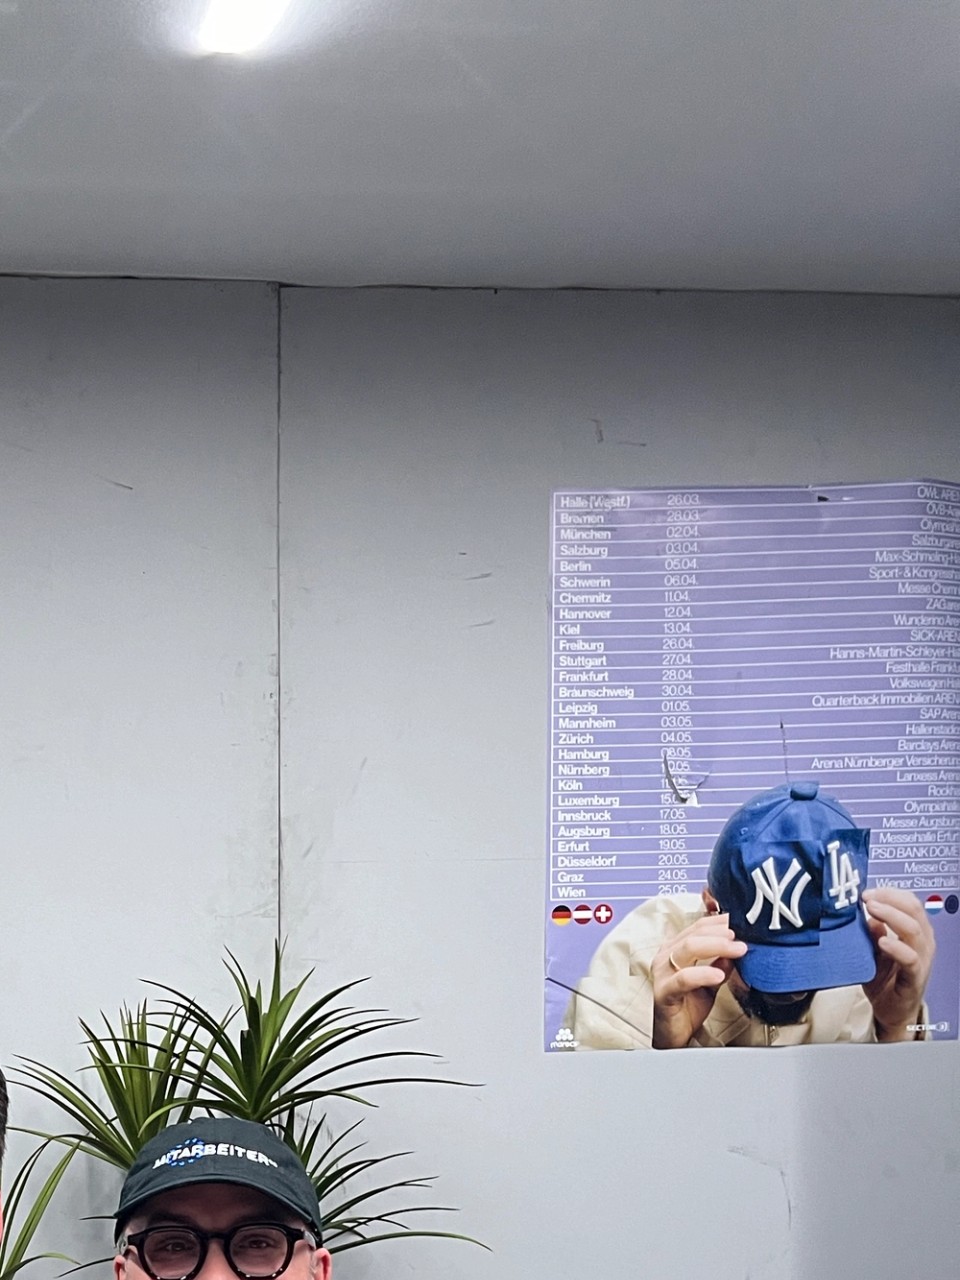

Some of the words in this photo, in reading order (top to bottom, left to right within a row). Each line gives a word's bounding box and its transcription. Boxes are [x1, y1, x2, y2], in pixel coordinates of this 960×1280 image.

[560, 512, 604, 524] Bremen
[560, 528, 611, 540] München
[560, 544, 608, 558] Salzburg
[559, 561, 591, 572] Berlin
[559, 576, 611, 588] Schwerin
[903, 567, 911, 577] &
[559, 592, 612, 603] Chemnitz
[898, 582, 930, 594] Messe
[559, 608, 612, 619] Hannover
[926, 598, 946, 610] ZAG
[559, 624, 580, 635] Kiel
[559, 640, 605, 653] Freiburg
[559, 655, 607, 668] Stuttgart
[559, 671, 609, 682] Frankfurt
[885, 661, 930, 673] Festhalle
[559, 686, 635, 700] Braunschweig
[889, 677, 945, 691] Volkswagen
[558, 702, 598, 716] Leipzig
[811, 694, 879, 707] Quarterback
[880, 692, 934, 705] Immobilien
[558, 717, 616, 729] Mannheim
[920, 707, 940, 719] SAP
[558, 732, 594, 744] Zürich
[558, 748, 610, 762] Hamburg
[897, 739, 939, 752] Barclays
[558, 764, 610, 777] Nürnberg
[811, 757, 843, 769] Arena
[844, 756, 905, 769] Nürnberger
[558, 780, 583, 791] Köln
[896, 770, 937, 782] Lanxess
[558, 795, 620, 807] Luxemburg
[557, 810, 612, 821] Innsbruck
[557, 826, 611, 838] Augsburg
[882, 817, 917, 829] Messe
[557, 841, 590, 852] Erfurt
[880, 832, 936, 843] Messehalle
[557, 856, 617, 867] Düsseldorf
[871, 847, 896, 859] PSD
[896, 846, 928, 858] BANK
[929, 846, 959, 857] DOME
[557, 872, 585, 882] Graz
[904, 862, 937, 873] Messe
[557, 887, 587, 898] Wien
